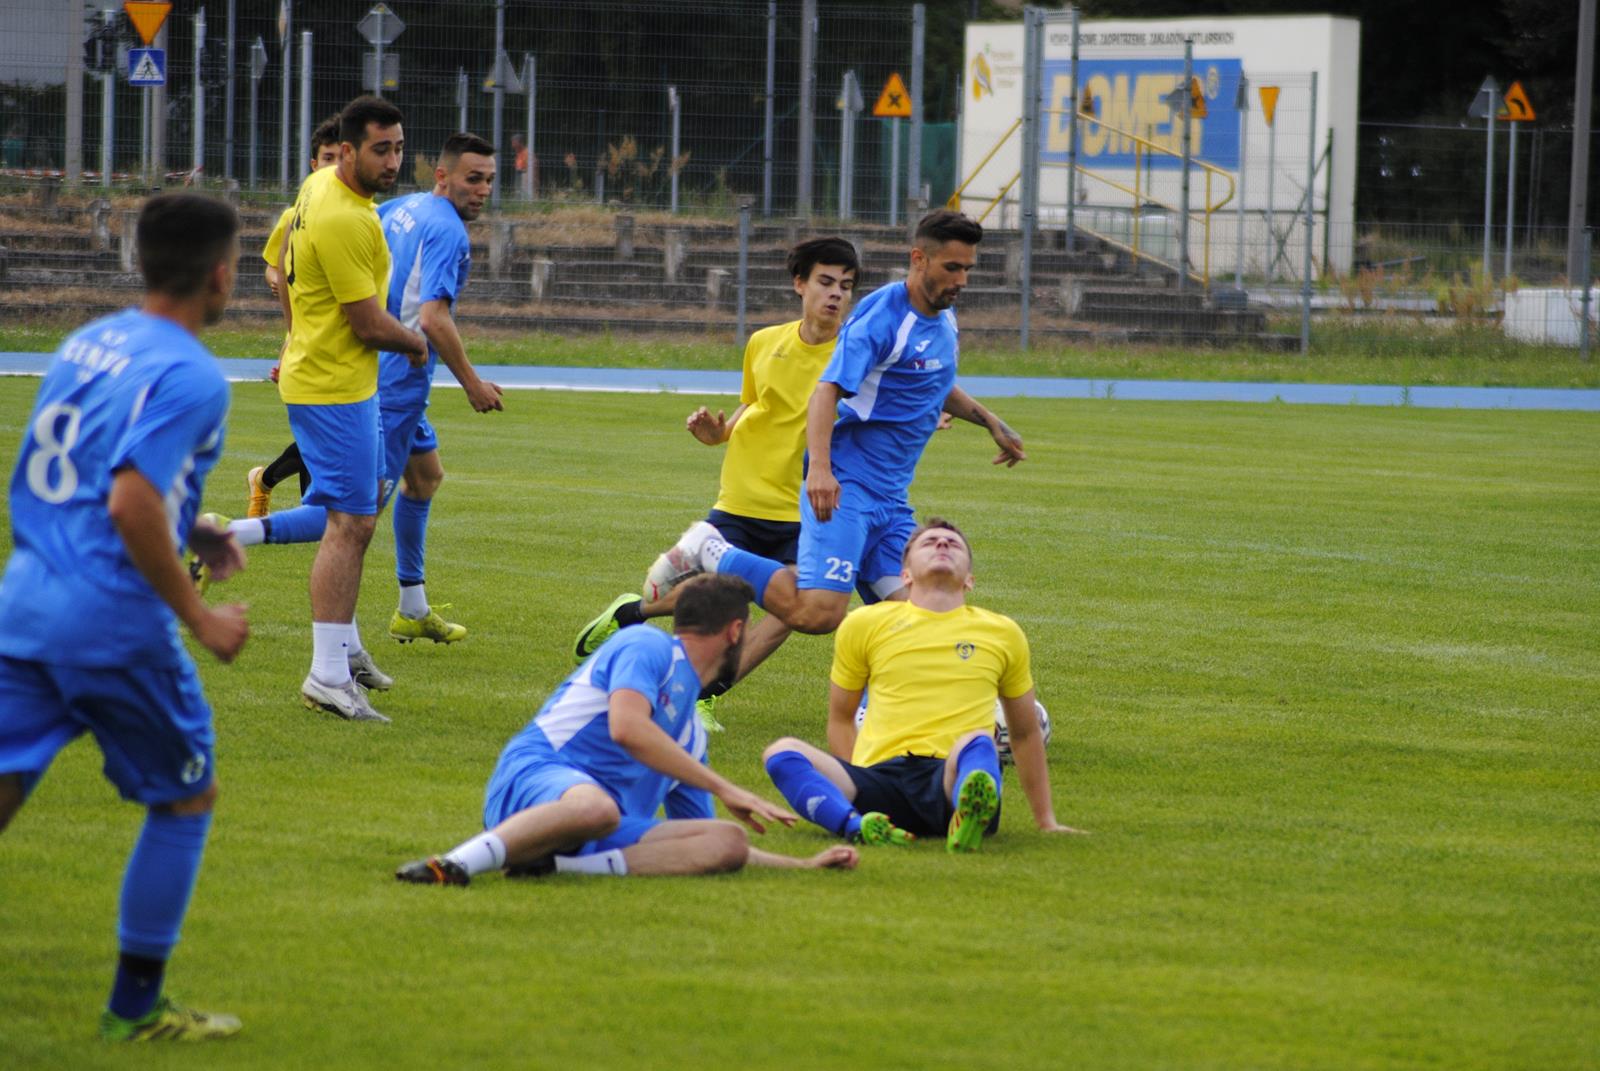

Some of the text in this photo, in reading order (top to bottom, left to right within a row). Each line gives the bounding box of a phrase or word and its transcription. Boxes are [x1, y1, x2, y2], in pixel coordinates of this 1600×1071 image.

[27, 403, 81, 504] 8
[824, 556, 853, 582] 23
[181, 752, 206, 784] 8
